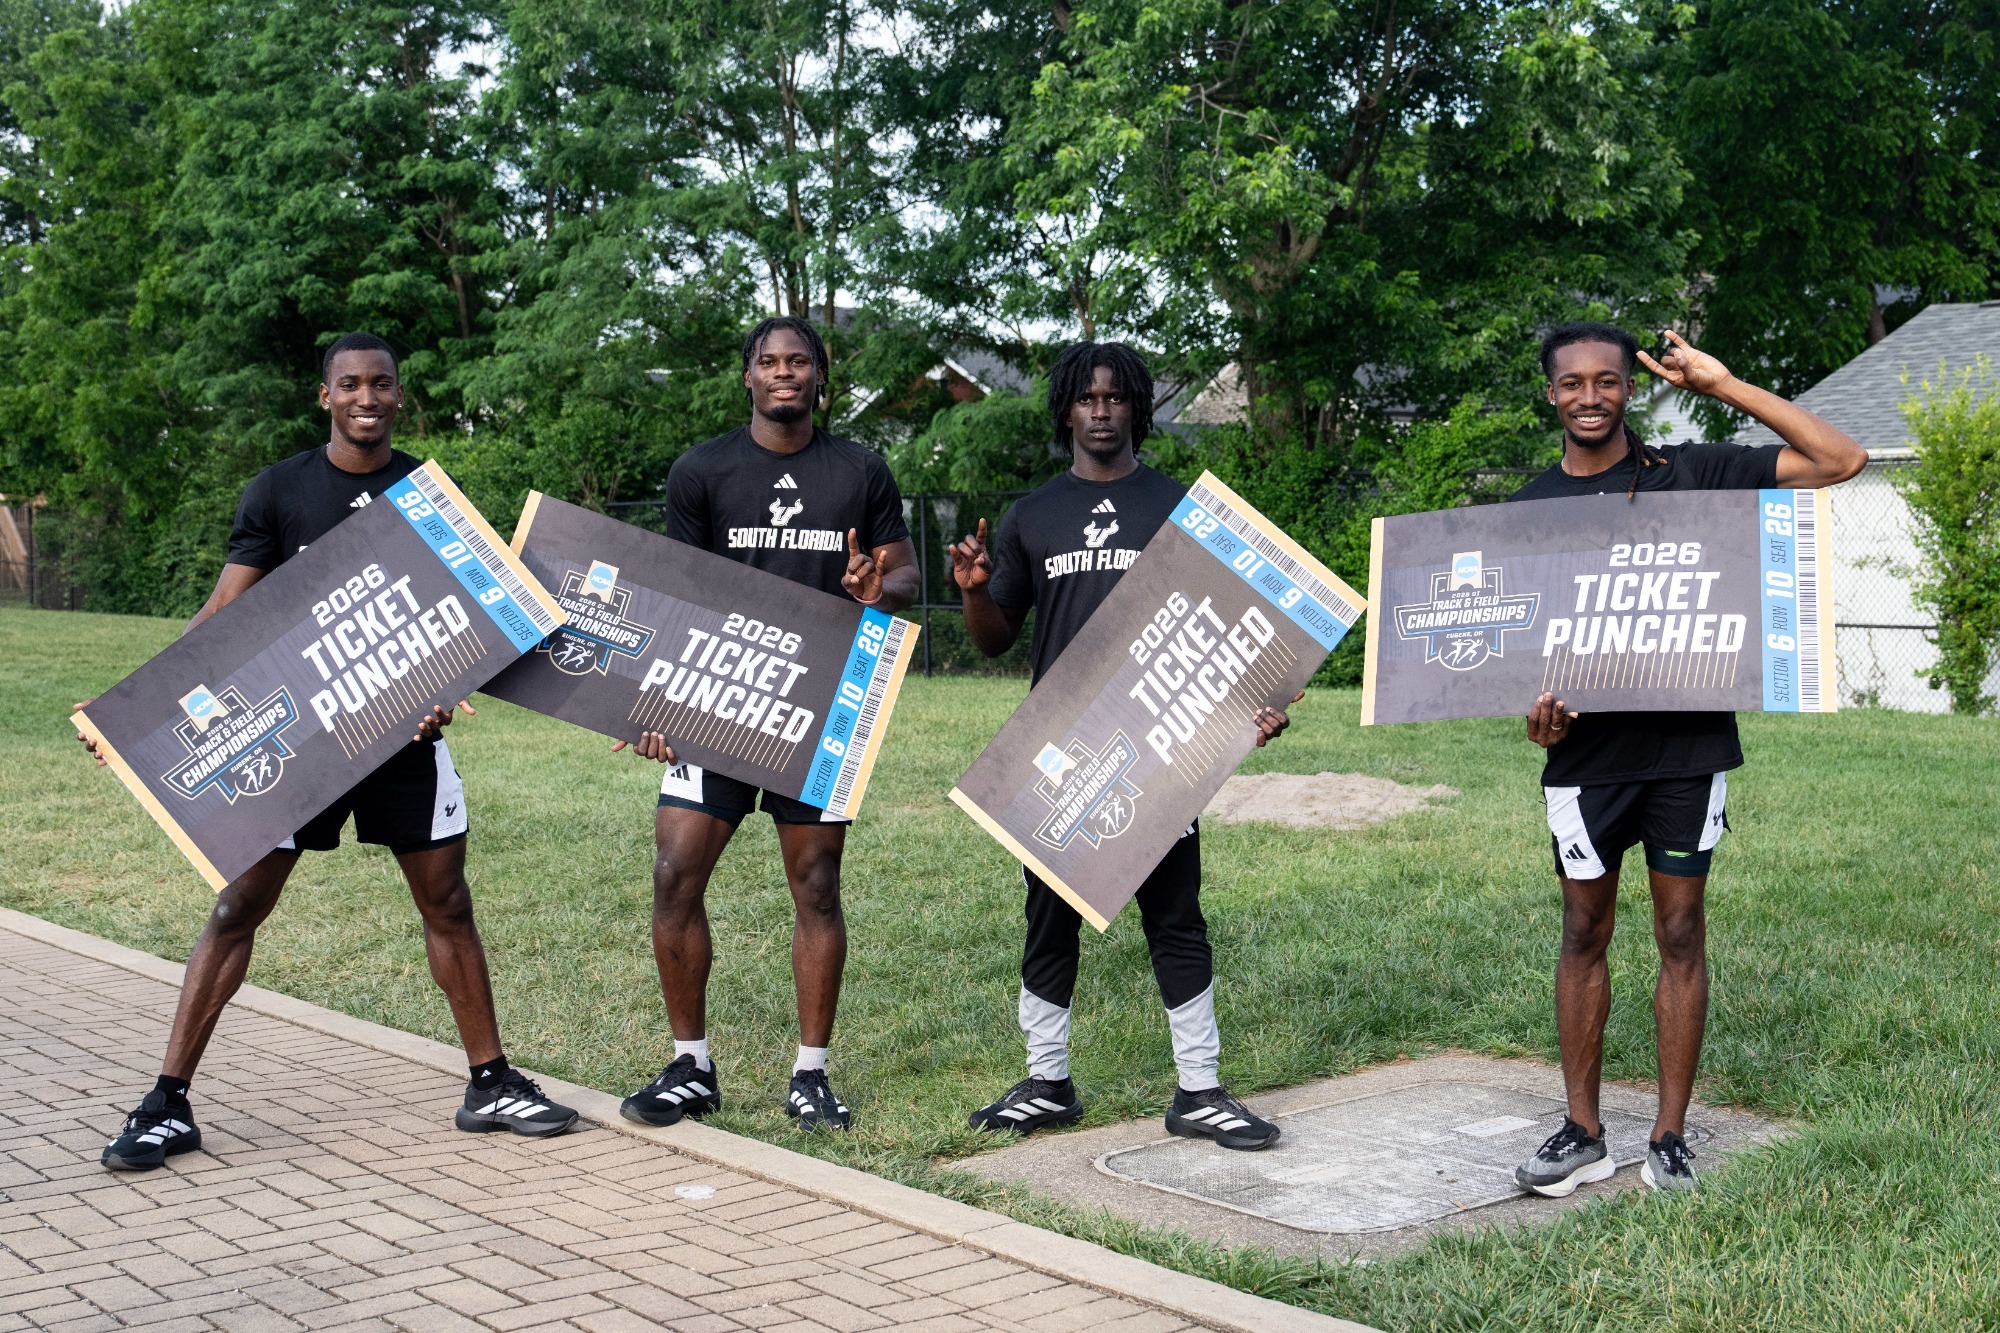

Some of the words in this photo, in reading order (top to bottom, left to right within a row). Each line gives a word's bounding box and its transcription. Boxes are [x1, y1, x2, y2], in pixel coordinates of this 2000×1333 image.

[396, 490, 435, 522] 26
[1764, 502, 1792, 537] 26
[423, 519, 448, 541] SEAT
[1182, 507, 1220, 539] 26
[440, 540, 474, 569] 10
[728, 527, 778, 548] SOUTH
[780, 528, 844, 552] FLORIDA
[1210, 533, 1236, 554] SEAT
[1609, 542, 1702, 567] 2026
[1770, 538, 1786, 564] SEAT
[465, 568, 489, 590] ROW
[1044, 549, 1094, 580] SOUTH
[1096, 548, 1142, 571] FLOR
[1232, 549, 1266, 579] 10
[1457, 565, 1479, 574] NCAA
[311, 563, 386, 628] 2026
[479, 586, 506, 606] 6
[591, 574, 612, 588] NCAA
[1260, 573, 1286, 595] ROW
[1574, 571, 1721, 613] TICKET
[1766, 570, 1794, 599] 10
[558, 596, 586, 614] TRACK
[587, 606, 596, 617] &
[595, 609, 622, 626] FIELD
[1278, 587, 1303, 609] 6
[1432, 599, 1461, 611] TRACK
[1463, 598, 1472, 608] &
[1472, 595, 1500, 607] FIELD
[301, 574, 421, 682] TICKET
[496, 604, 534, 641] SECTION
[1129, 591, 1189, 666] 2026
[1297, 603, 1337, 638] SECTION
[1406, 604, 1527, 630] CHAMPIONSHIPS
[1772, 605, 1788, 631] ROW
[721, 612, 802, 655] 2026
[857, 620, 886, 657] 26
[1542, 613, 1747, 657] PUNCHED
[1767, 633, 1796, 652] 6
[309, 594, 470, 733] PUNCHED
[679, 627, 809, 698] TICKET
[852, 652, 870, 679] SEAT
[1128, 595, 1227, 717] TICKET
[1145, 606, 1275, 766] PUNCHED
[1773, 656, 1789, 703] SECTION
[192, 697, 214, 715] NCAA
[638, 658, 815, 744] PUNCHED
[837, 680, 865, 711] 10
[193, 735, 224, 759] TRACK
[222, 727, 232, 738] &
[229, 709, 256, 733] FIELD
[832, 712, 850, 738] ROW
[181, 702, 287, 788] CHAMPIONSHIPS
[253, 746, 264, 756] OR
[822, 735, 846, 757] 6
[811, 757, 835, 799] SECTION
[1049, 745, 1128, 841] CHAMPIONSHIPS
[1055, 787, 1079, 812] TRACK
[1075, 778, 1084, 788] &
[1080, 757, 1101, 782] FIELD
